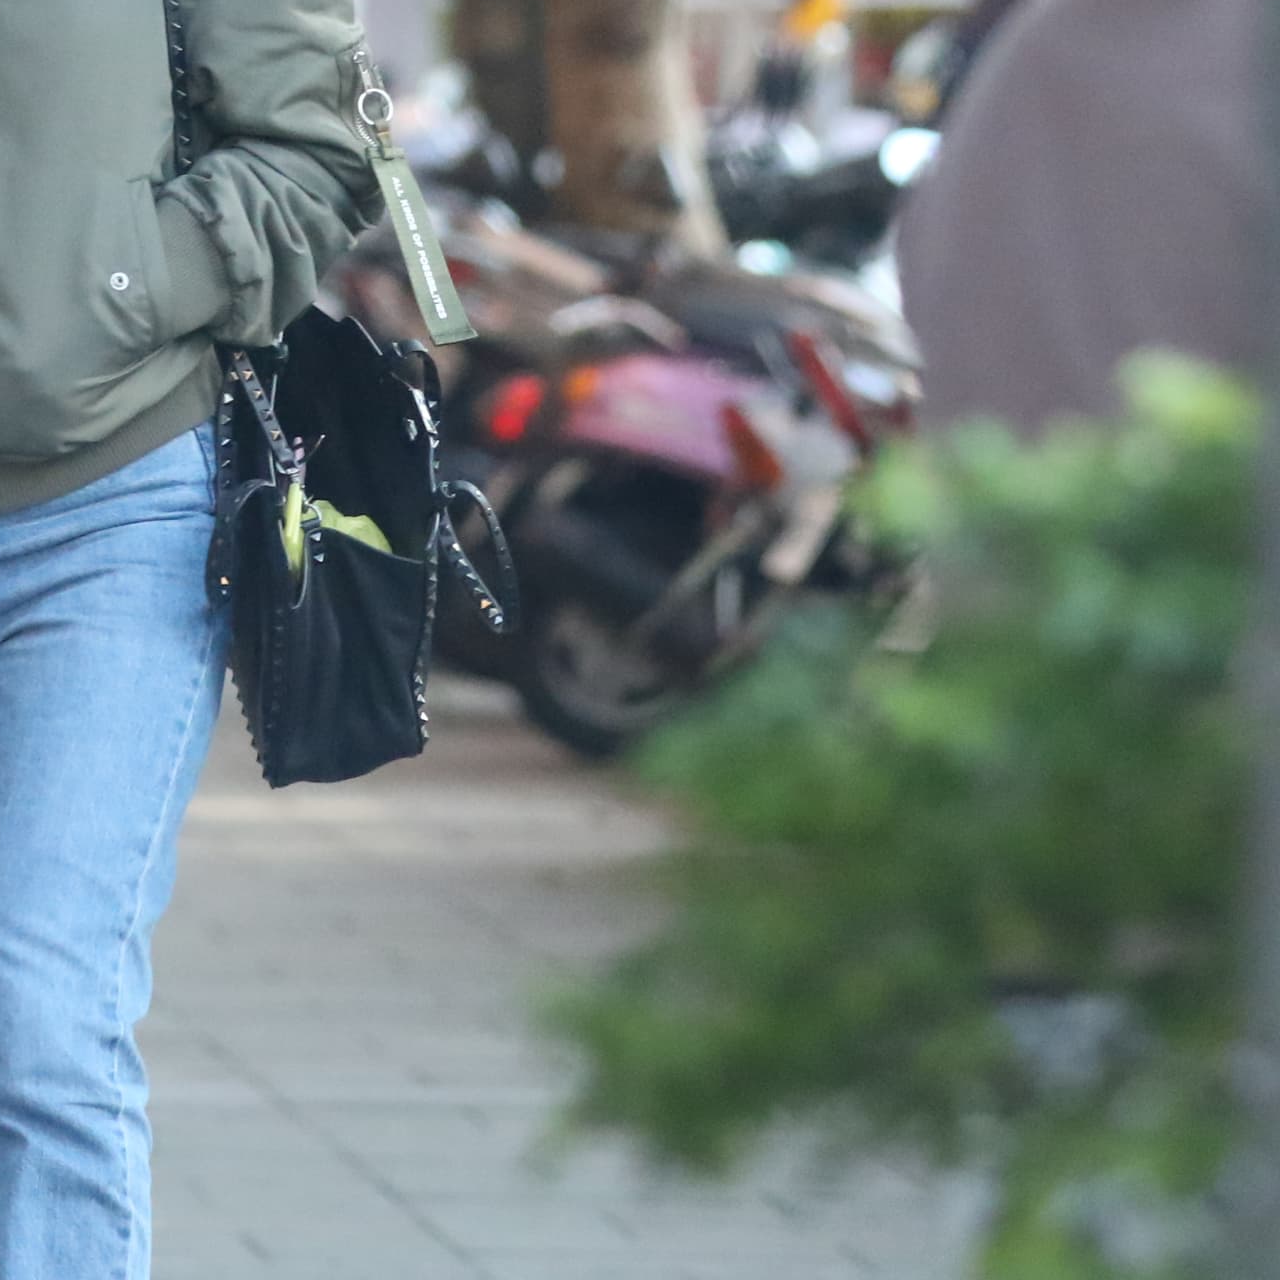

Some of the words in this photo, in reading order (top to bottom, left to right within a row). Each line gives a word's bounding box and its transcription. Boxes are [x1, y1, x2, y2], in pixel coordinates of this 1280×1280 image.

[392, 176, 404, 197] ALL
[400, 199, 417, 231] KINDS
[412, 233, 423, 248] OF
[417, 249, 448, 319] POSSIBILITIES
